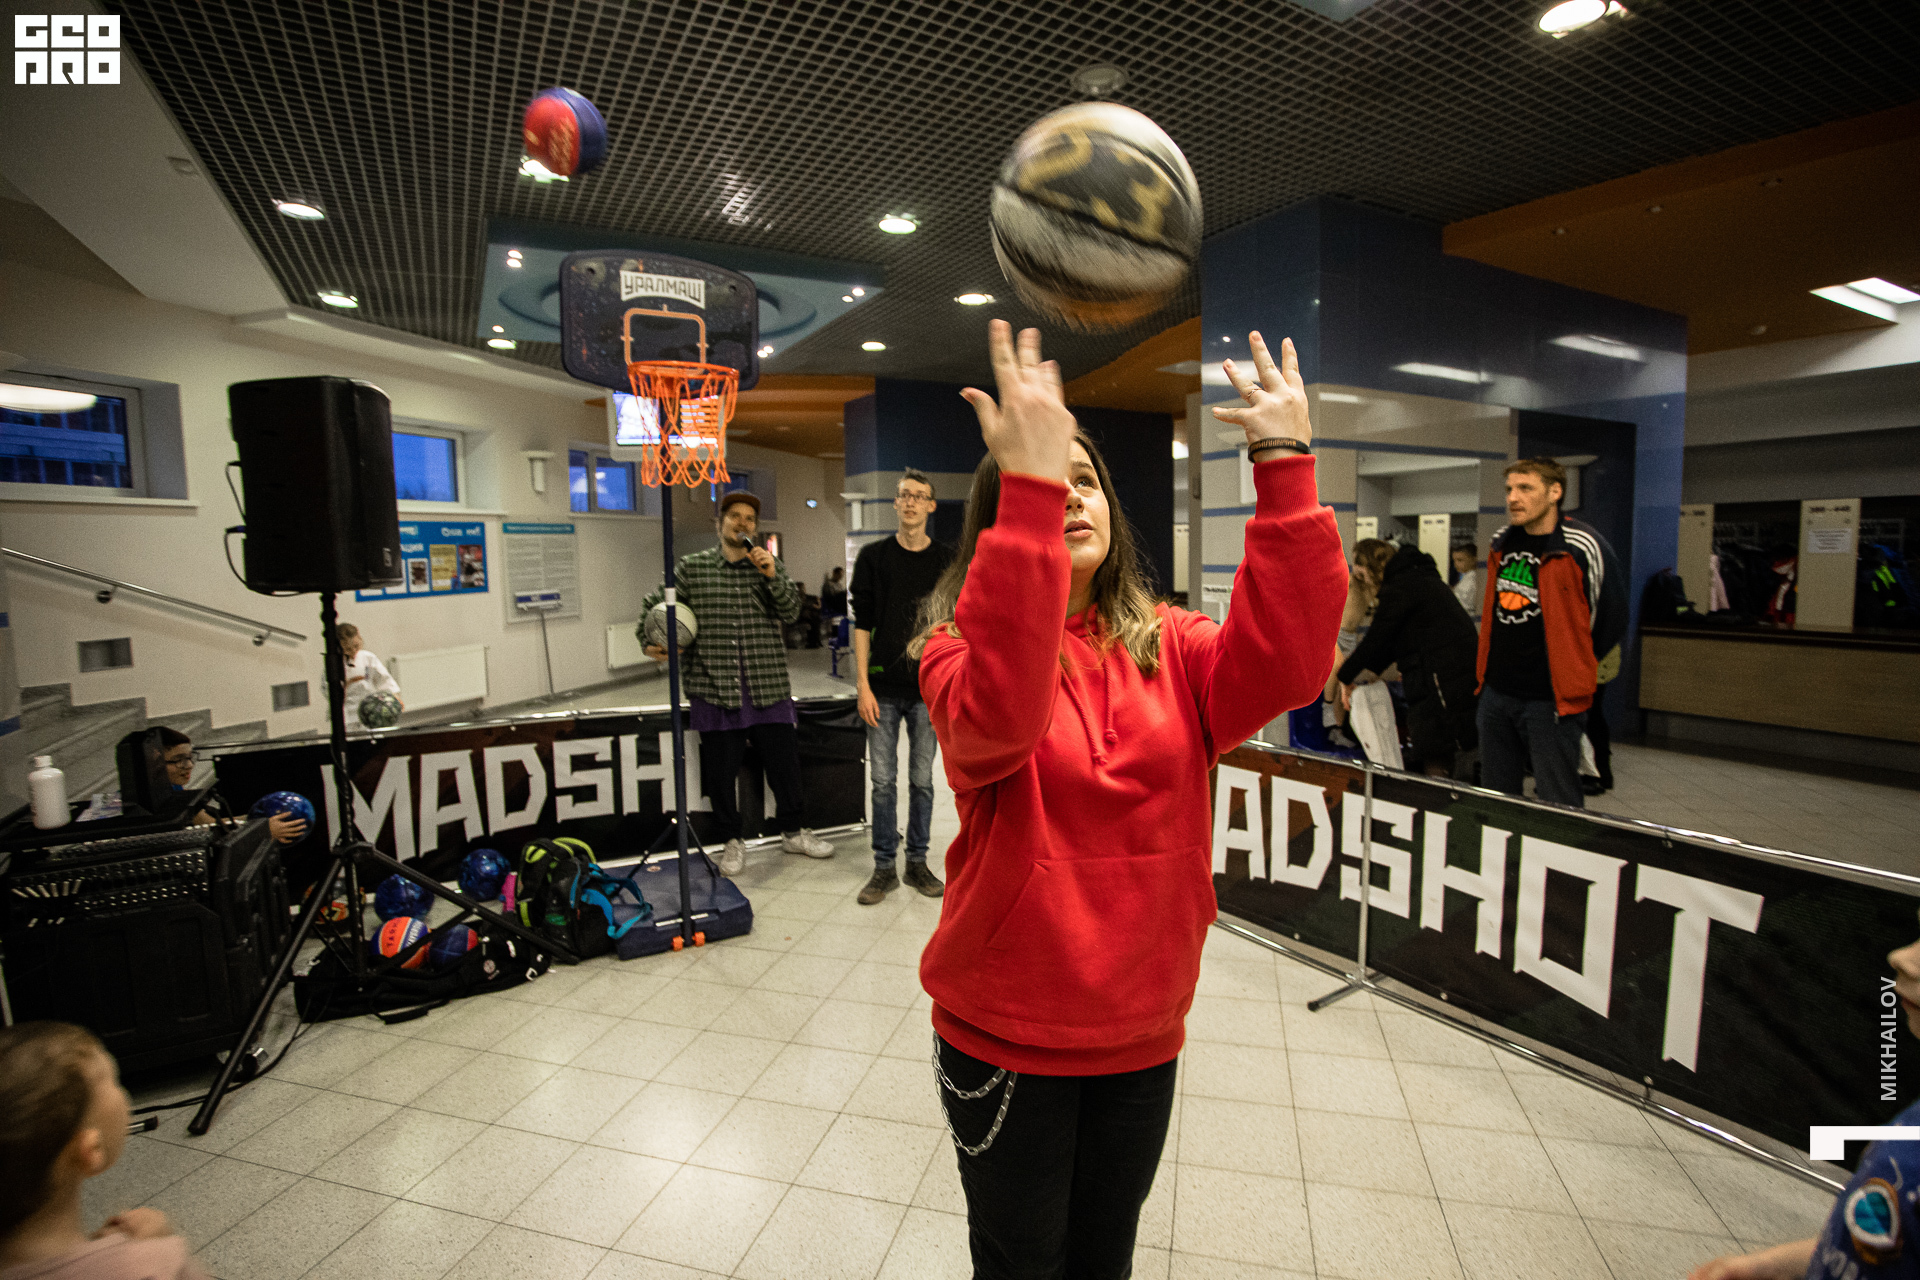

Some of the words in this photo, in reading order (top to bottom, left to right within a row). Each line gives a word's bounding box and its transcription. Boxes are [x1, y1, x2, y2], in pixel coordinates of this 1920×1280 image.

[624, 273, 702, 301] УРАЛМАШ
[320, 729, 777, 864] MADSH
[1211, 763, 1764, 1073] ADSHOT
